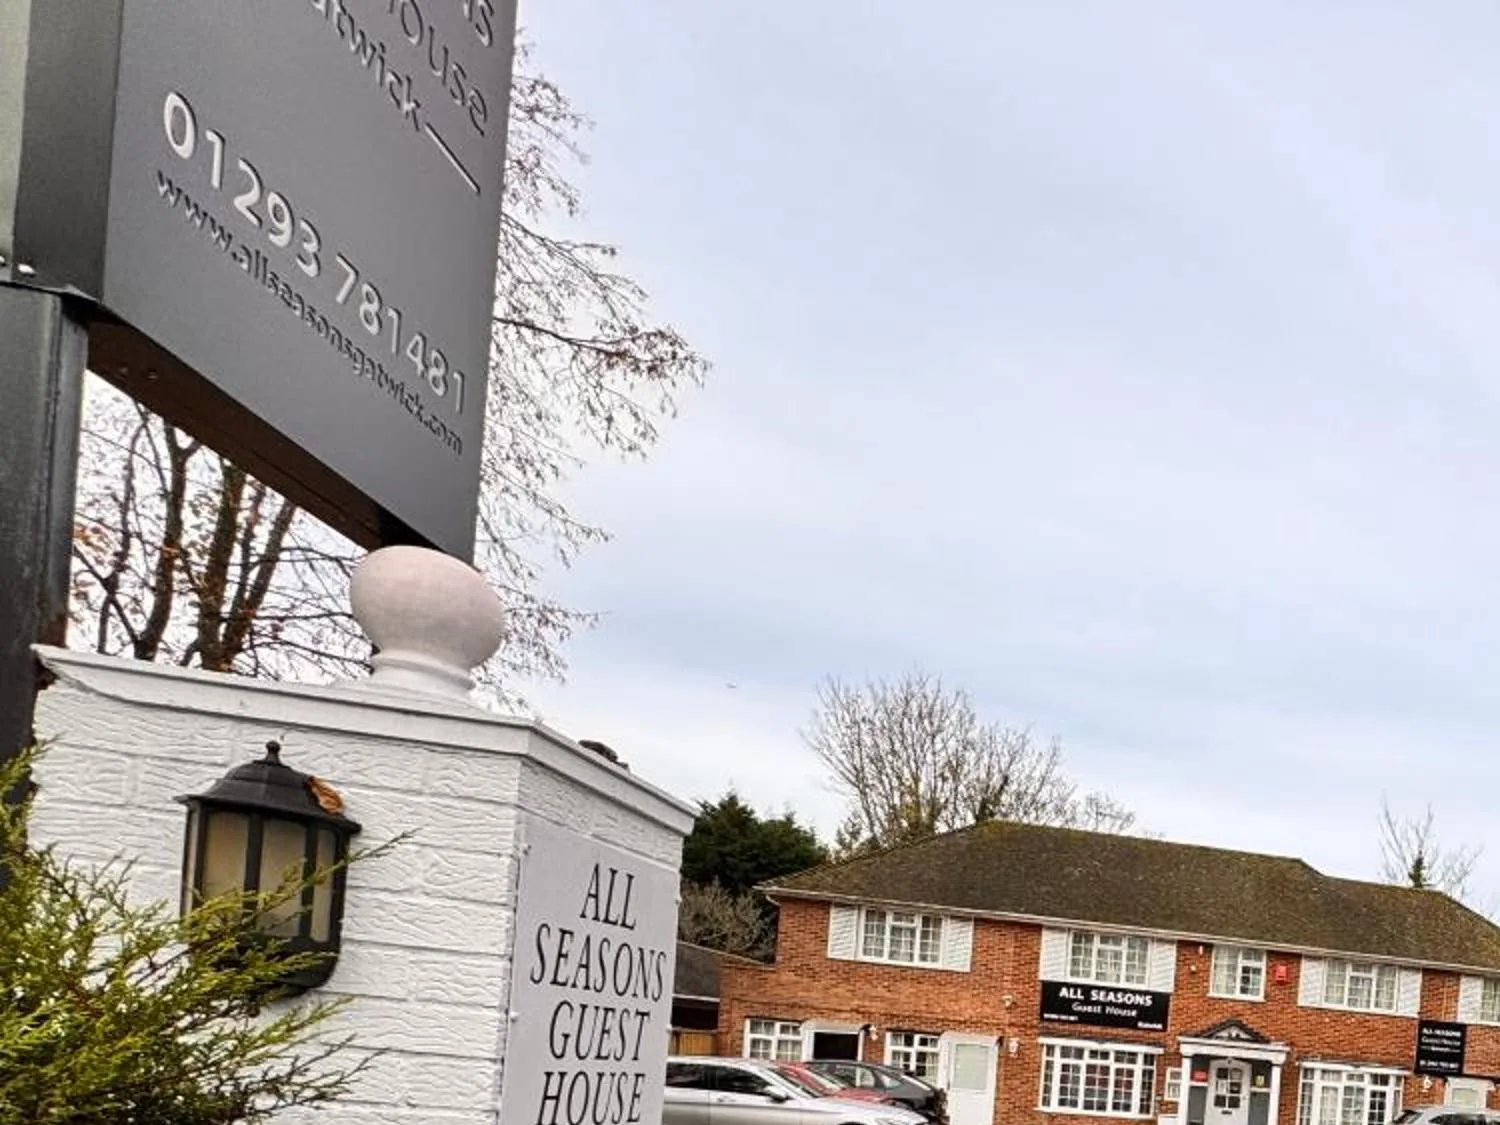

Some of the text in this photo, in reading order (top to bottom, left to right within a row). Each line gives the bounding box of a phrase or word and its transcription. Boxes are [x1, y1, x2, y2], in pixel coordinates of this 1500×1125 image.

[163, 91, 466, 415] 01293 781481
[157, 169, 464, 456] www.allseasonsgatwick.com
[579, 862, 638, 931] ALL
[530, 922, 668, 1003] SEASONS
[1059, 986, 1153, 1007] ALL SEASONS
[548, 1000, 650, 1062] GUEST
